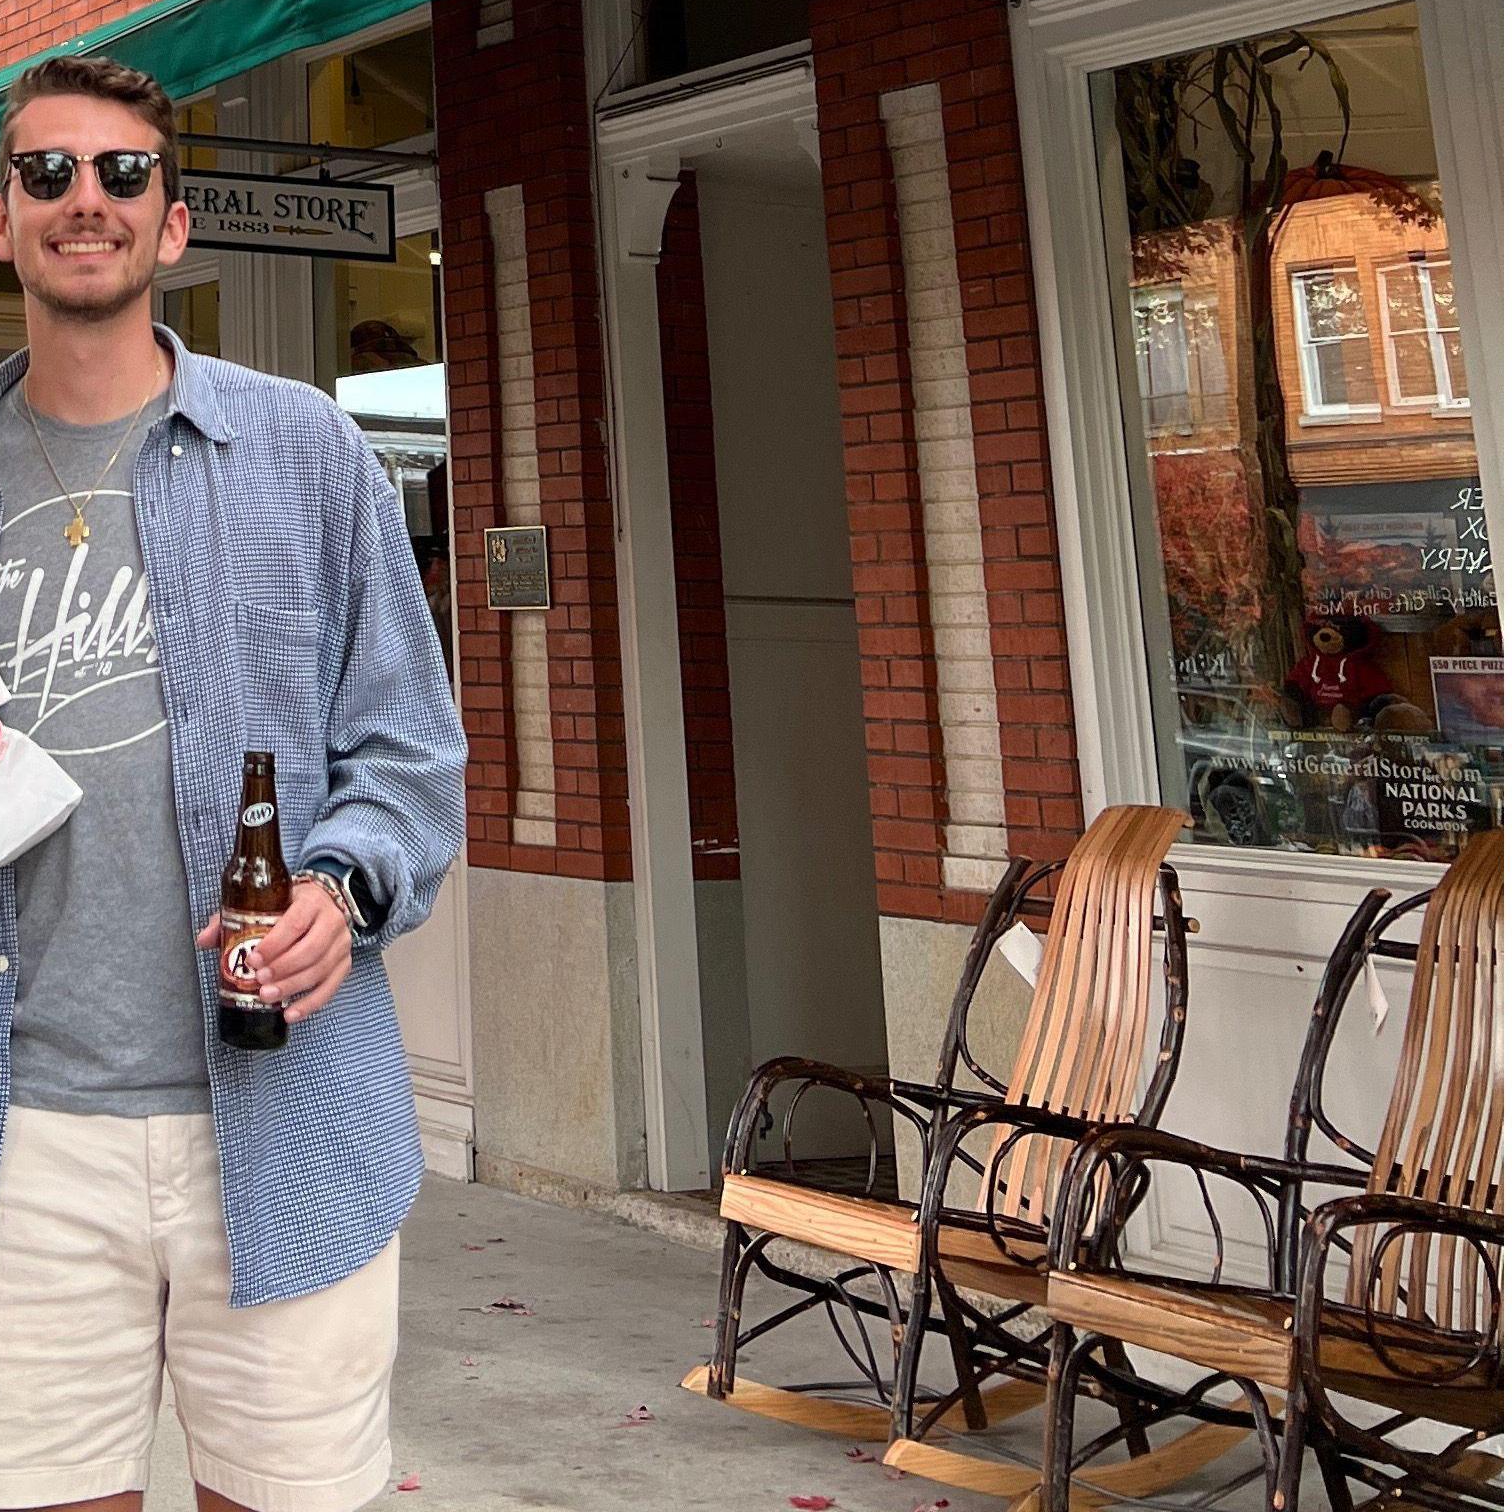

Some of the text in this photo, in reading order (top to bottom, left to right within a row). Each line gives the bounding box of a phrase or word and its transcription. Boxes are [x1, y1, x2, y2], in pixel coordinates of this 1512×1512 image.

[218, 218, 270, 234] 1883
[274, 193, 375, 242] STORE
[1452, 659, 1478, 670] PIECE
[1385, 782, 1481, 803] NATIONAL
[1402, 801, 1467, 820] PARKS
[1404, 819, 1468, 832] COOKBOOK
